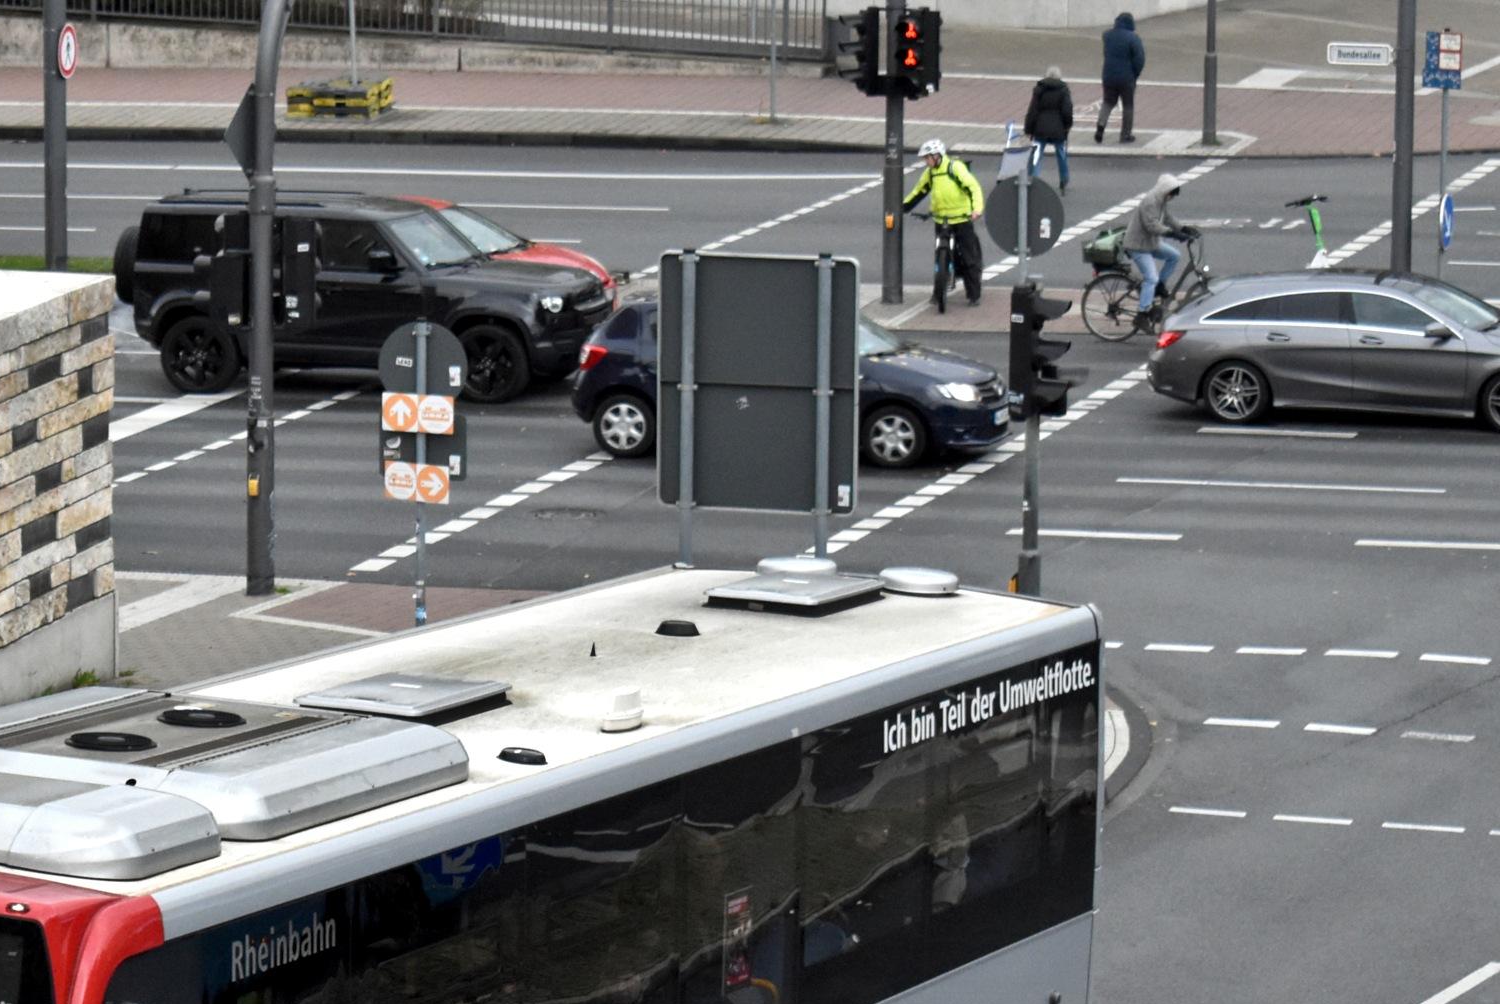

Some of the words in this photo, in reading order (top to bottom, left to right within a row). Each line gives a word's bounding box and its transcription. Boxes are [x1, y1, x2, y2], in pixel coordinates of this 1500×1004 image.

[1337, 49, 1381, 59] Bundesallee
[883, 713, 906, 753] Ich
[911, 705, 936, 744] bin
[939, 691, 966, 733] Teil
[970, 686, 996, 723] der
[1000, 658, 1095, 713] Umweltflotte.
[231, 912, 336, 982] Rheinbahn
